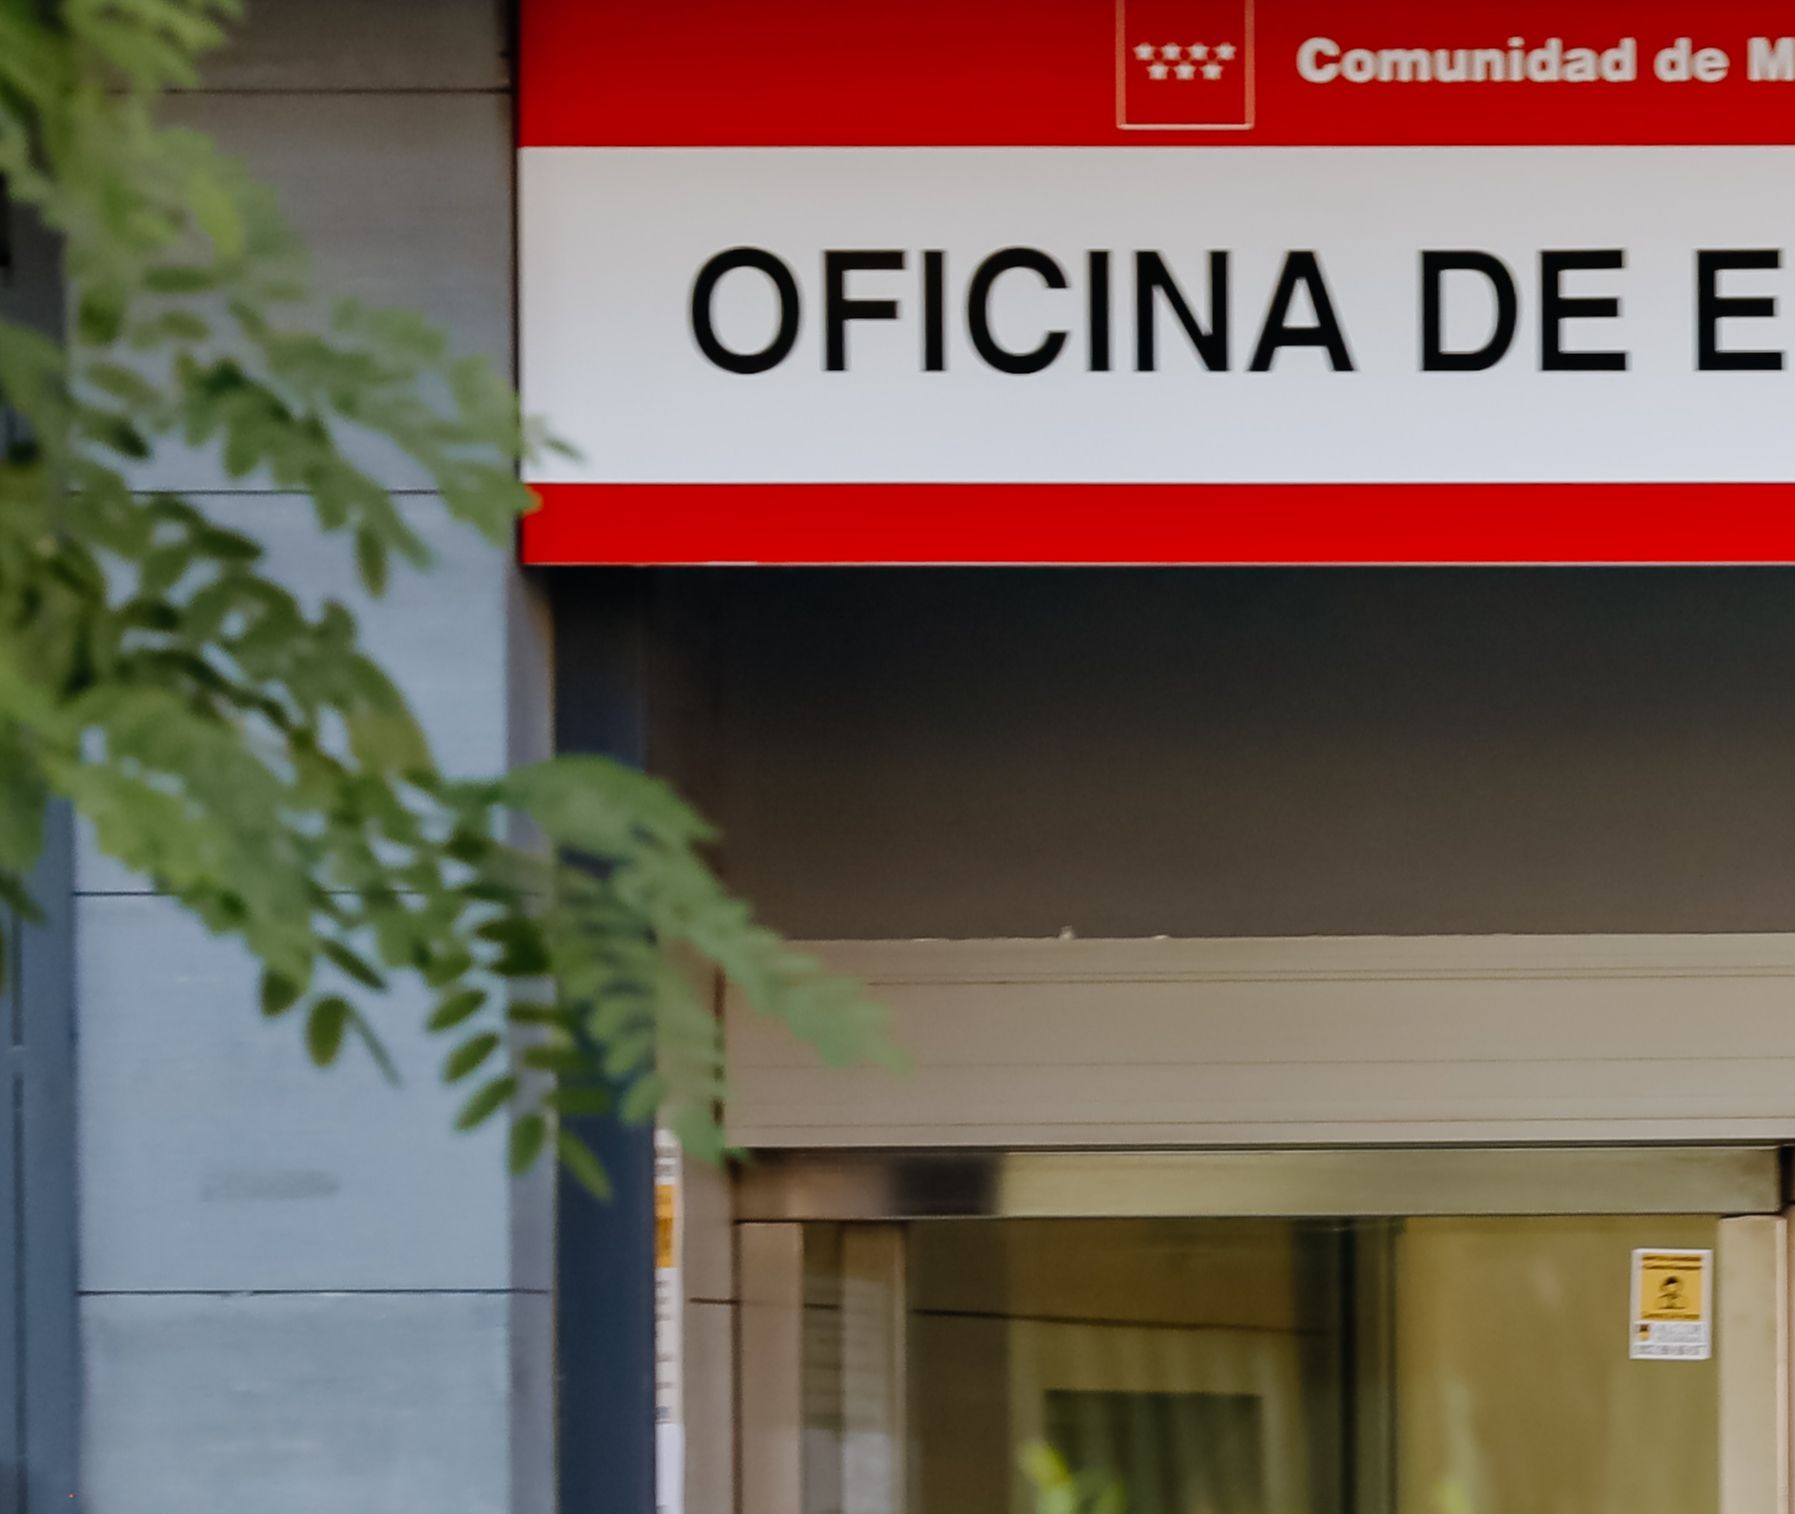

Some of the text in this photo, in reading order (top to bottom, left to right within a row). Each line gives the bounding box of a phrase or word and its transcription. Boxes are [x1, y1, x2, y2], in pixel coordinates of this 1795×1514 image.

[1297, 36, 1636, 85] Comunidad
[1650, 36, 1731, 84] de
[690, 245, 1353, 376] OFICINA
[1418, 247, 1630, 373] DE
